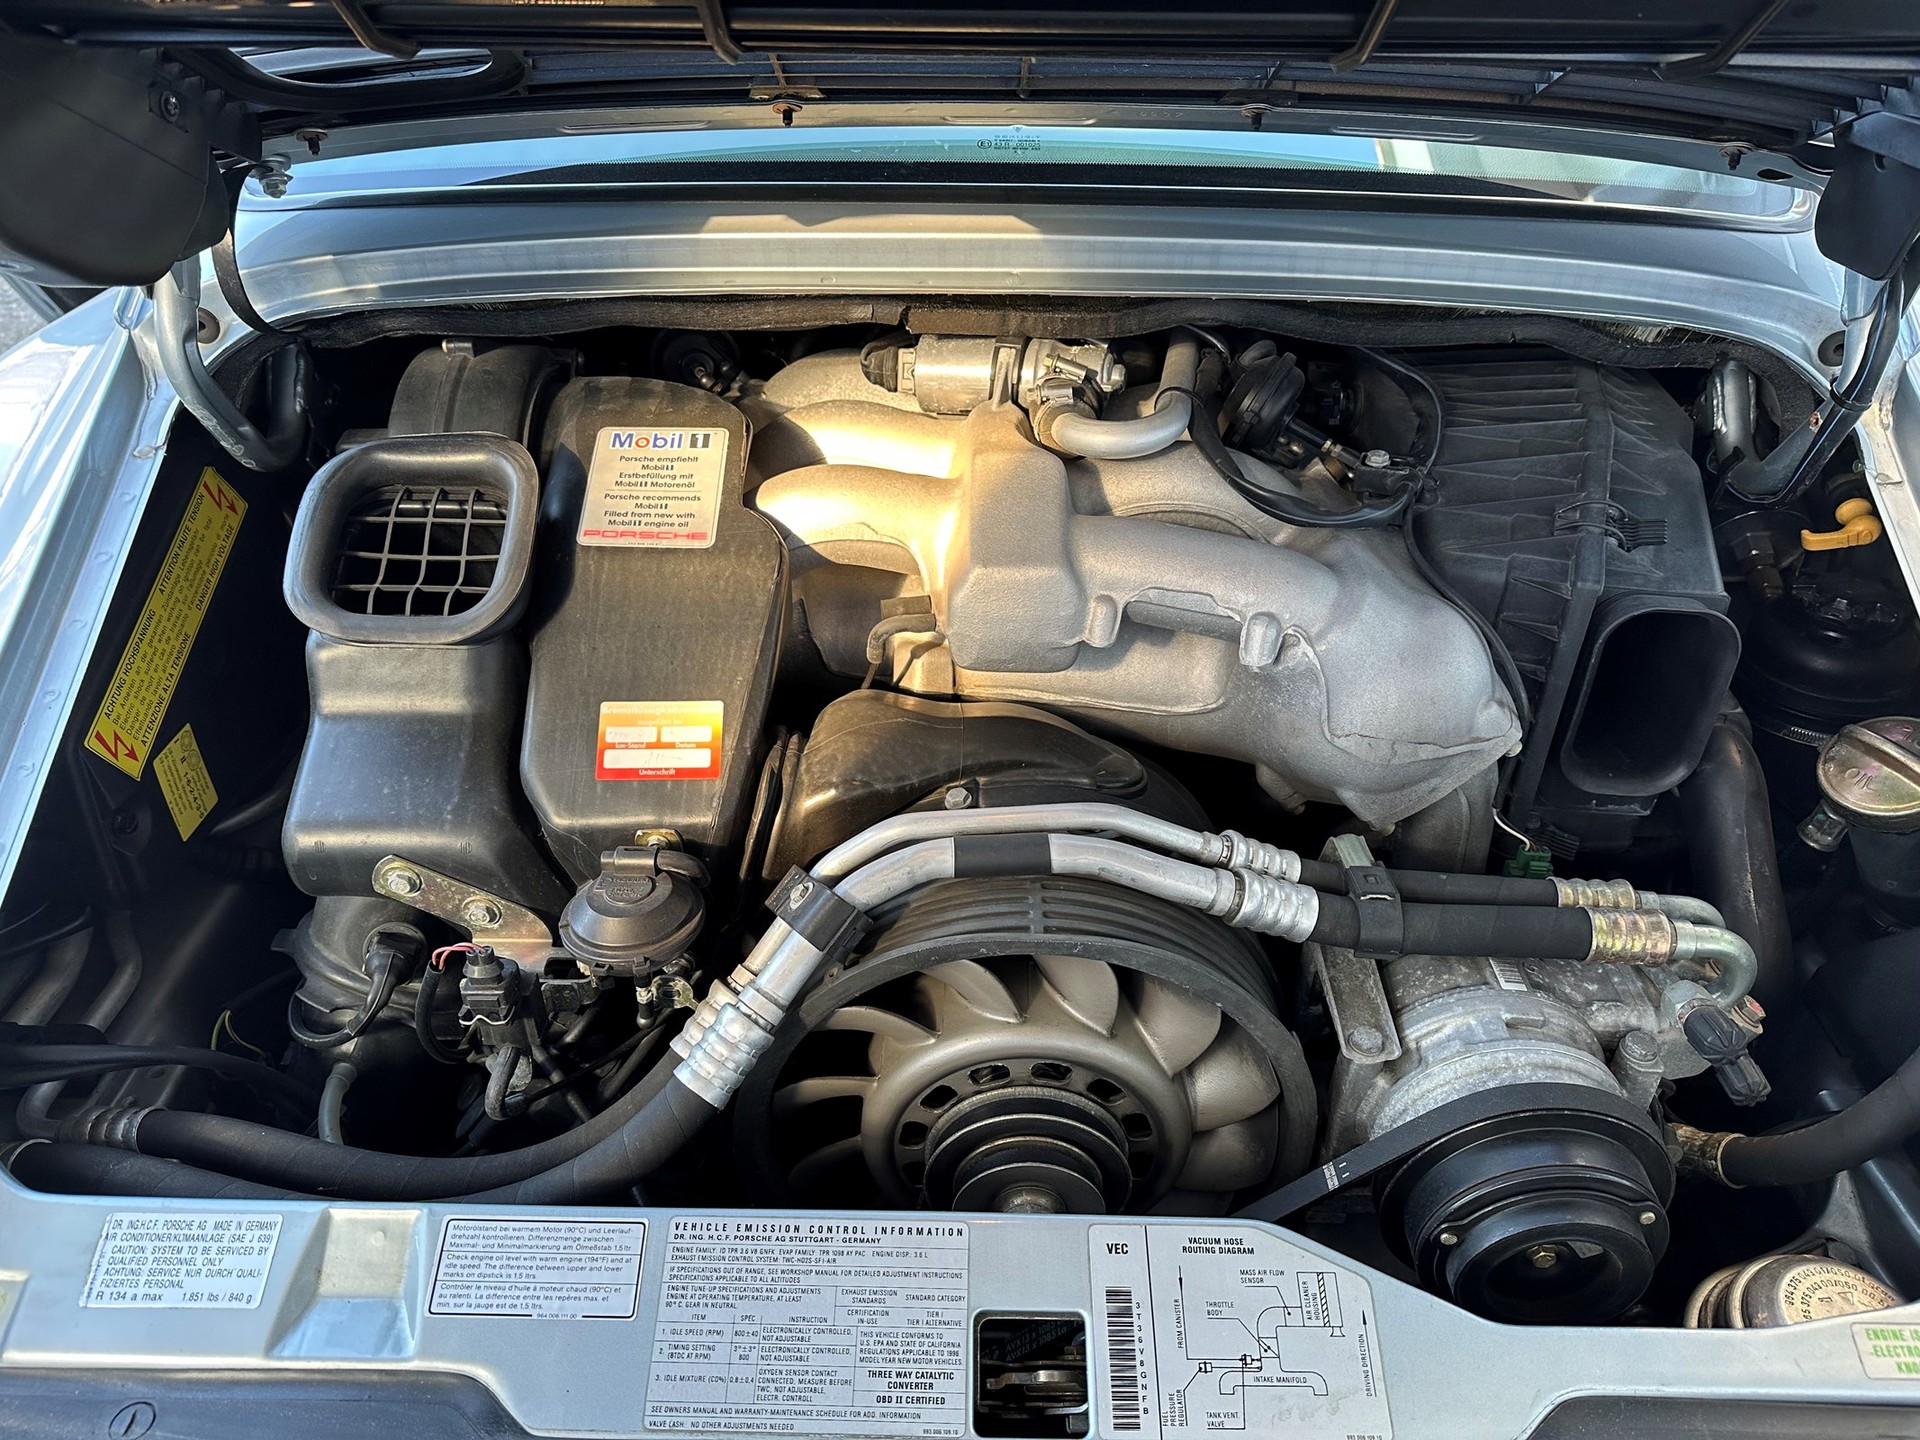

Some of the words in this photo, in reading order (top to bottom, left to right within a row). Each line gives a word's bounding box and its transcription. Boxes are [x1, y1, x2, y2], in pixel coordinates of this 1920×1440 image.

[611, 432, 684, 448] Mobil
[690, 434, 711, 448] 1
[657, 456, 698, 464] empfiehlt
[584, 530, 708, 540] PORSCHE
[158, 550, 180, 596] ATTENTION
[178, 527, 192, 550] HAUTE
[188, 492, 205, 524] TENSION
[196, 578, 213, 612] DANGER
[209, 560, 220, 579] HIGH
[219, 524, 234, 559] VOLTAGE
[104, 678, 126, 720] ACHTUNG
[123, 610, 156, 678] HOCHSPANNUNG
[141, 694, 166, 747] ATTENZIONE
[164, 672, 175, 695] ALTA
[171, 631, 191, 671] TENSIONE
[162, 1220, 194, 1230] PORSCHE
[196, 1220, 207, 1230] AG
[213, 1221, 232, 1231] MADE
[236, 1221, 243, 1231] IN
[246, 1221, 278, 1231] GERMANY
[675, 1222, 728, 1232] VEHICLE
[736, 1224, 800, 1233] EMISSION
[810, 1225, 866, 1234] CONTROL
[874, 1226, 963, 1236] INFORMATION
[103, 1232, 117, 1240] AIR
[228, 1234, 246, 1244] (SAE
[248, 1234, 254, 1242] J
[258, 1234, 274, 1244] 639)
[112, 1245, 147, 1254] CAUTION:
[152, 1246, 183, 1255] SYSTEM
[188, 1246, 198, 1255] TO
[201, 1246, 212, 1255] BE
[216, 1246, 254, 1255] SERVICED
[258, 1246, 269, 1256] BY
[1106, 1243, 1128, 1254] VEC
[108, 1256, 148, 1266] QUALIFIED
[152, 1256, 196, 1266] PERSONNEL
[202, 1257, 224, 1266] ONLY
[147, 1268, 181, 1277] SERVICE
[184, 1268, 202, 1278] NUR
[205, 1268, 232, 1278] DURCH
[236, 1268, 262, 1278] QUALI-
[100, 1278, 140, 1288] FIZIERTES
[143, 1279, 184, 1288] PERSONAL
[96, 1291, 104, 1300] R
[110, 1292, 126, 1301] 134
[131, 1293, 138, 1301] a
[142, 1293, 164, 1301] max
[207, 1292, 219, 1302] lbs
[228, 1292, 244, 1302] 840
[246, 1294, 252, 1304] g
[1302, 1280, 1311, 1306] CLEANER
[1312, 1292, 1321, 1320] HOUSING
[1174, 1298, 1182, 1330] CANISTER
[1864, 1328, 1906, 1341] ENGINE
[1358, 1334, 1368, 1367] DIRECTION
[1895, 1362, 1920, 1374] KNO
[868, 1370, 892, 1378] THREE
[896, 1371, 912, 1379] WAY
[915, 1371, 954, 1380] CATALYTIC
[888, 1381, 934, 1390] CONVERTER
[1363, 1368, 1373, 1397] DRIVING
[876, 1396, 892, 1404] OBD
[896, 1396, 902, 1404] II
[906, 1396, 946, 1404] CERTIFIED
[1168, 1393, 1177, 1426] PRESSURE
[1176, 1389, 1184, 1426] REGULATOR
